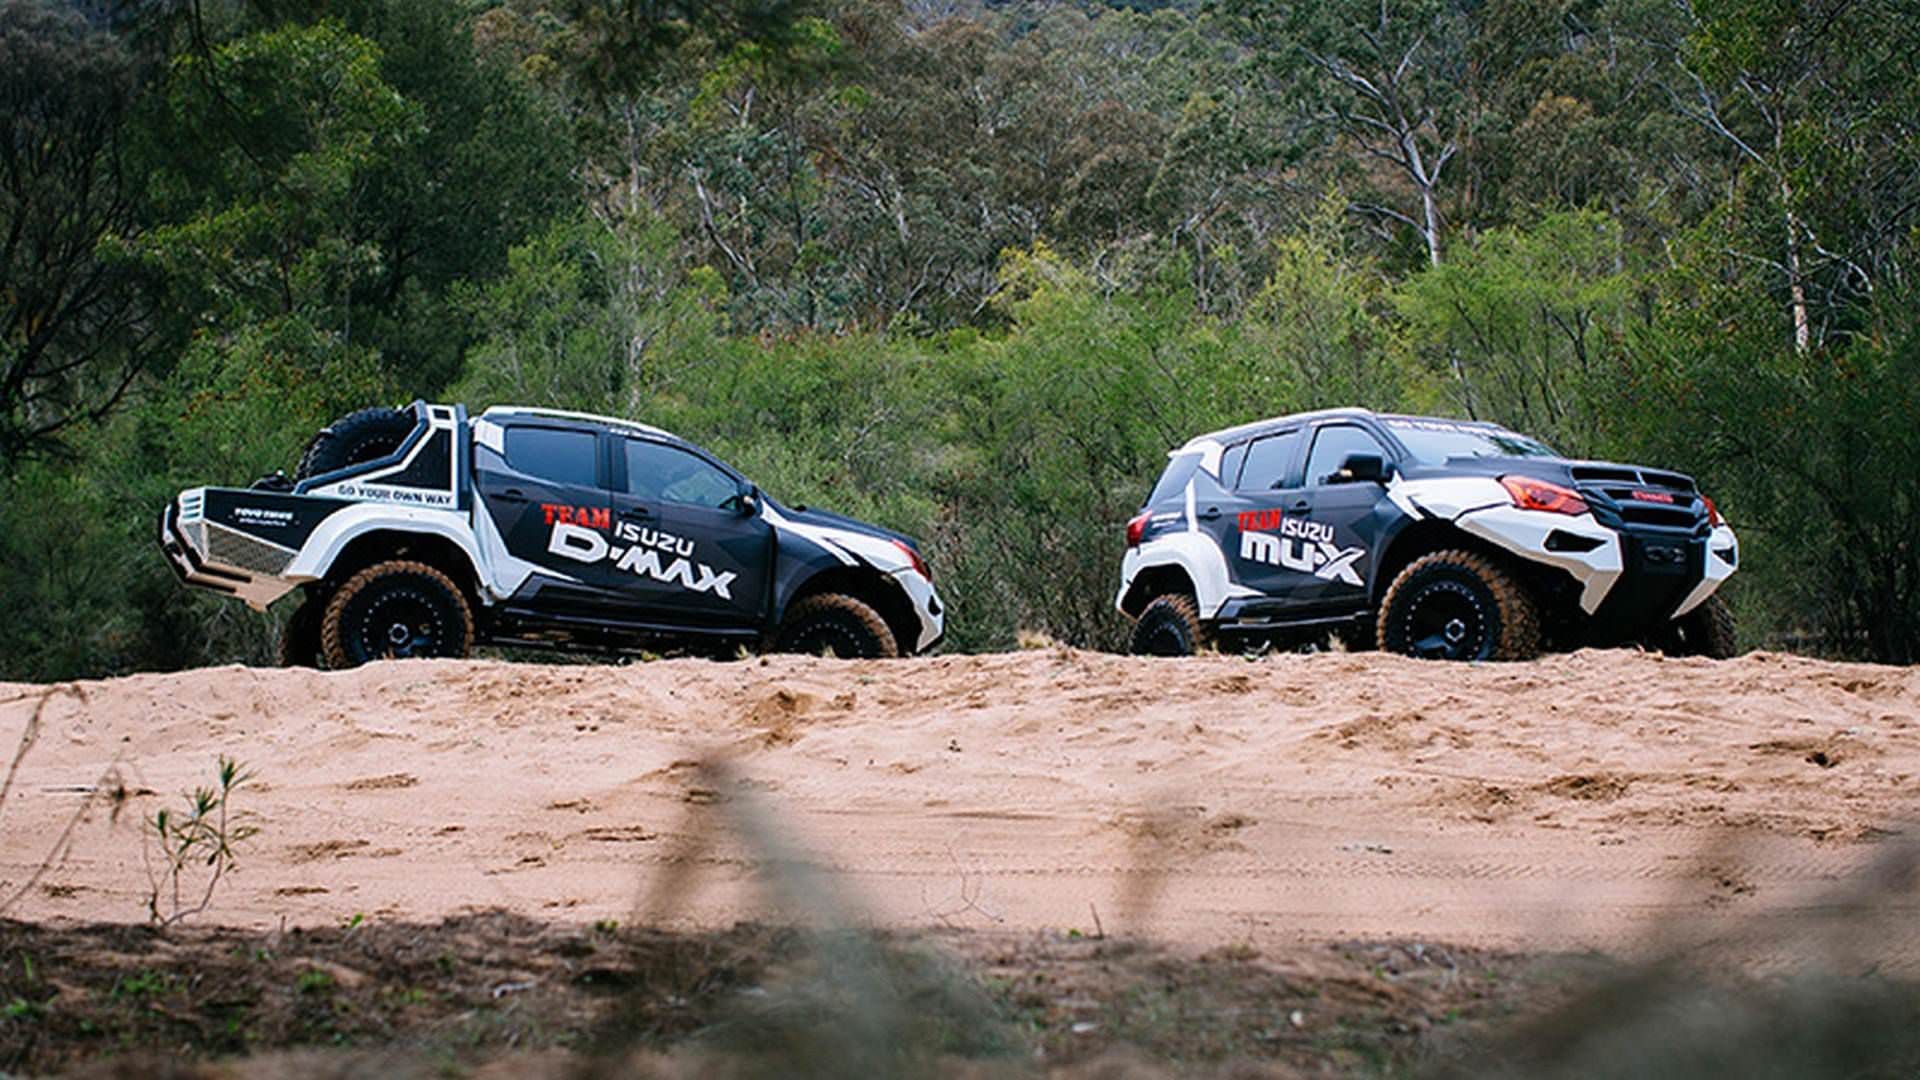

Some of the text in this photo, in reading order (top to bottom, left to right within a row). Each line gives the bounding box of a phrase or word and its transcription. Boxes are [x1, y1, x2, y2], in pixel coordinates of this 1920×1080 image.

[424, 494, 452, 505] WAY
[540, 503, 694, 557] TEAM ISUZU
[1237, 508, 1334, 542] TEAM ISUZU
[548, 520, 737, 600] D-MAX
